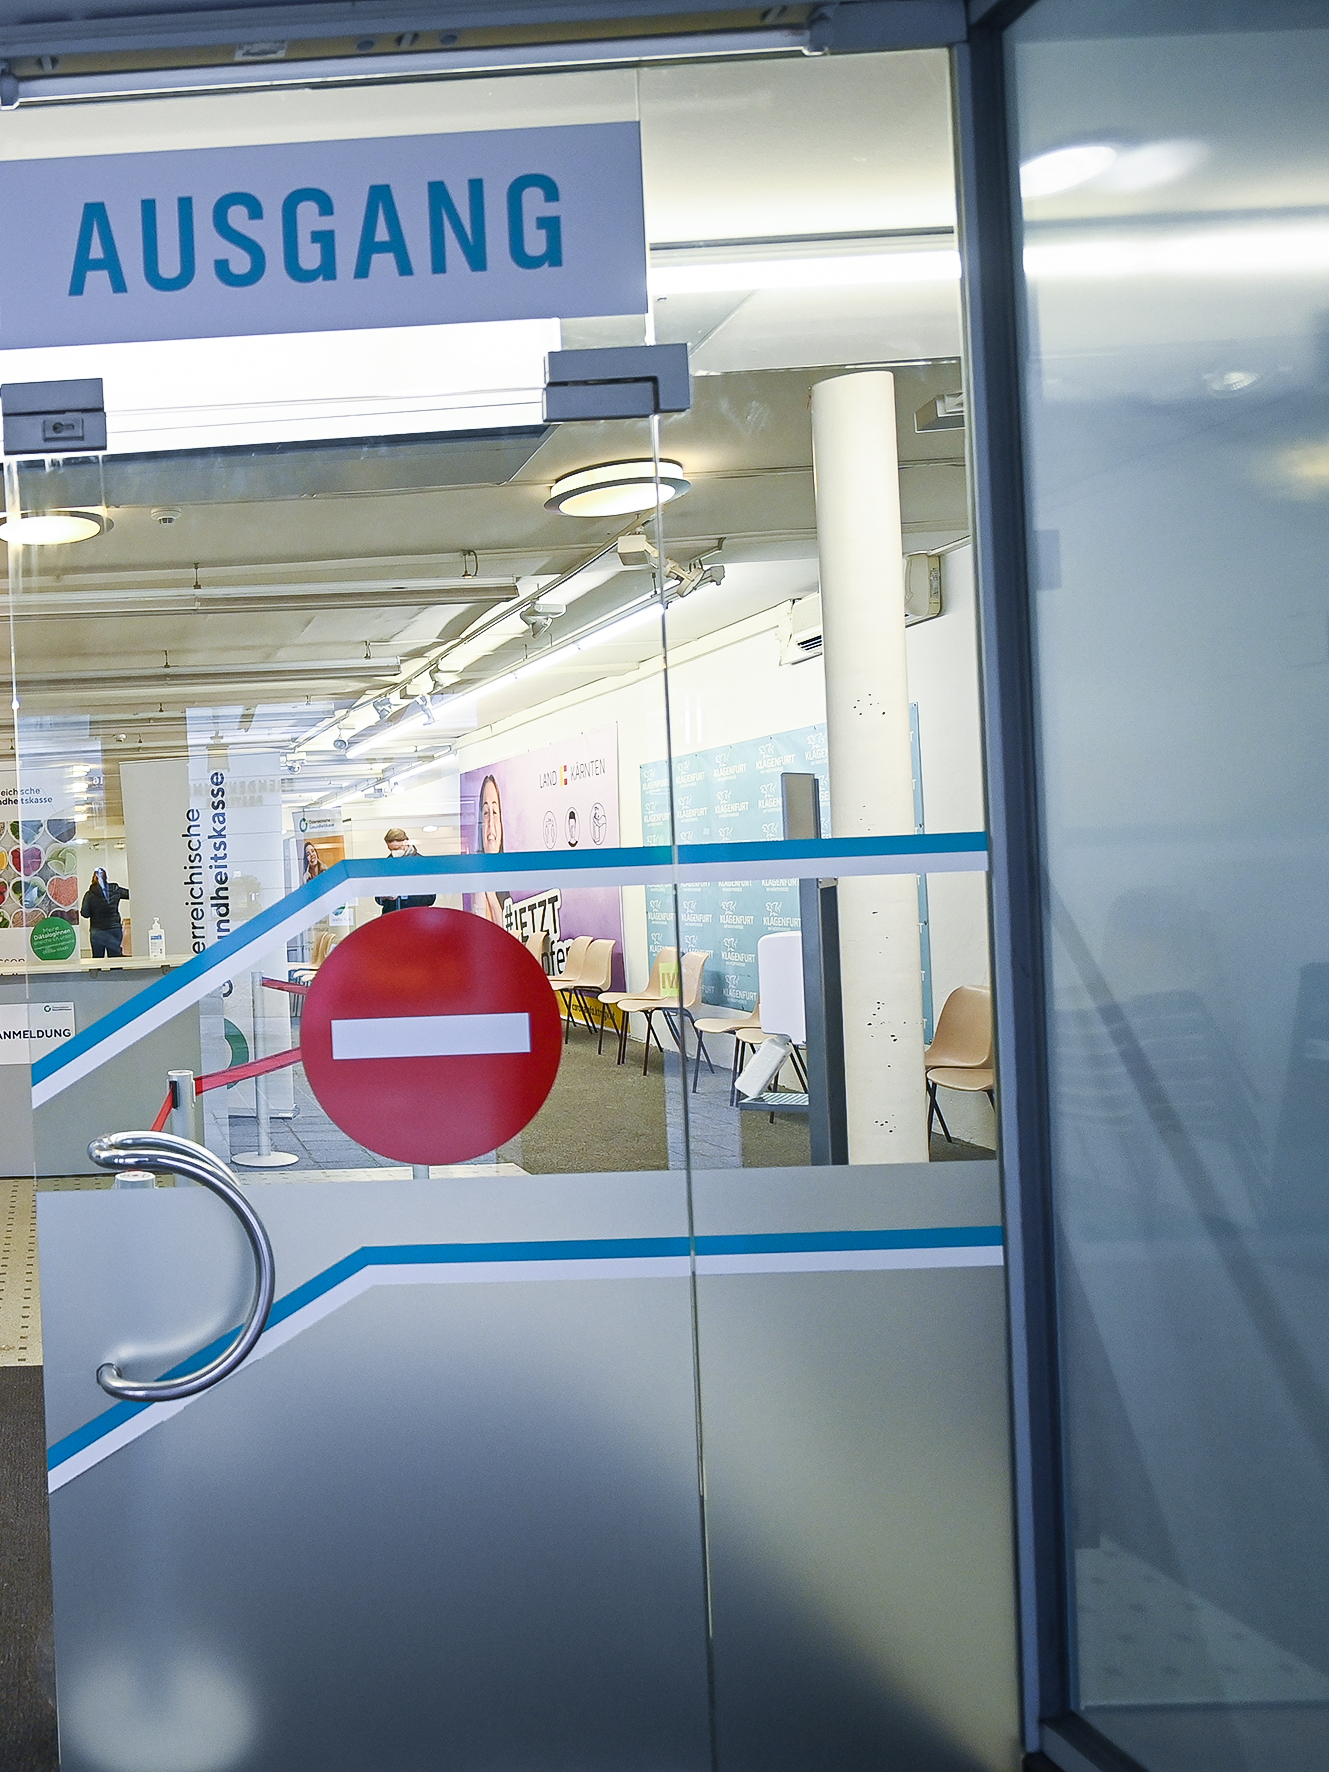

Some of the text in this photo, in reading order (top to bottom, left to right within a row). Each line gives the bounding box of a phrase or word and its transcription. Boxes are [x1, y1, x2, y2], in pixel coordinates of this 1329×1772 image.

[68, 172, 564, 297] AUSGANG
[755, 754, 795, 770] KLAGENFURT
[539, 758, 605, 788] LAND KÄRNTEN
[713, 763, 746, 777] KLAGENFURT
[676, 771, 705, 784] KLAGENFURT
[676, 807, 708, 819] KLAGENFURT
[714, 802, 749, 814] KLAGENFURT
[681, 914, 712, 923] KLAGENFURT
[720, 915, 754, 925] KLAGENFURT
[763, 916, 801, 928] KLAGENFURT
[722, 952, 755, 963] KLAGENFURT
[722, 988, 757, 1001] KLAGENFURT
